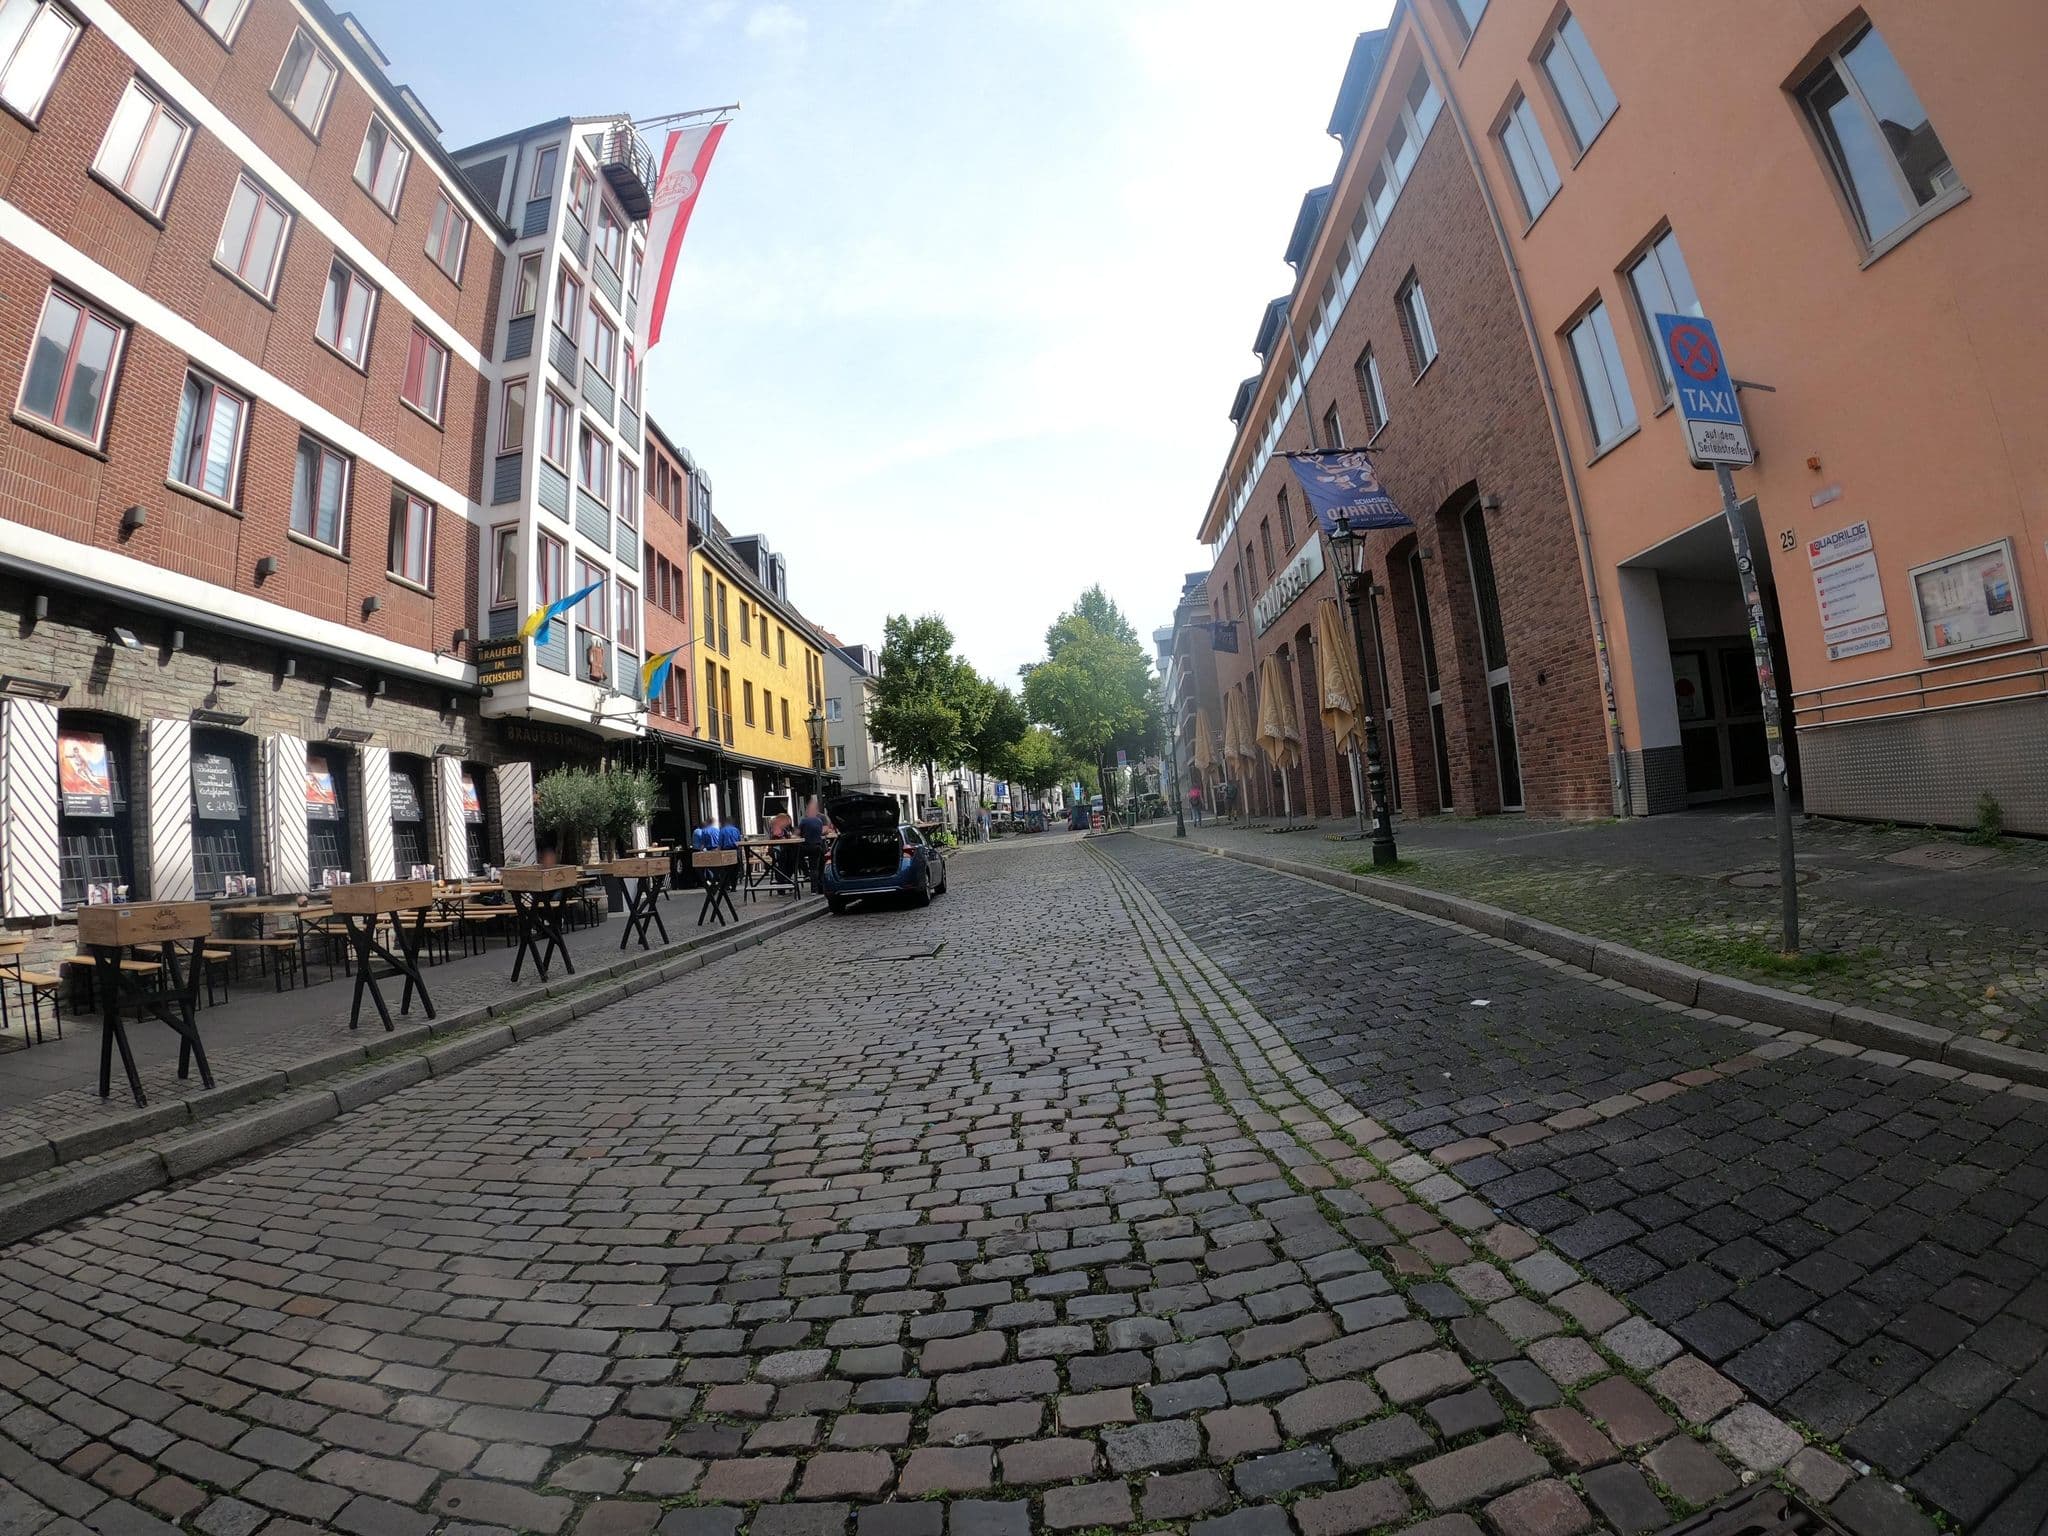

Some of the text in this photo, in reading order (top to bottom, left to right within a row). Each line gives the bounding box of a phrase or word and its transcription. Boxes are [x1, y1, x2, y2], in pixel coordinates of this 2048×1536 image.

[1683, 388, 1733, 414] TAXI
[1705, 429, 1735, 440] auf dem
[1781, 530, 1794, 549] 25
[1814, 524, 1866, 550] QUADRILOG
[479, 645, 521, 660] BRAUEREI
[495, 661, 504, 669] IM
